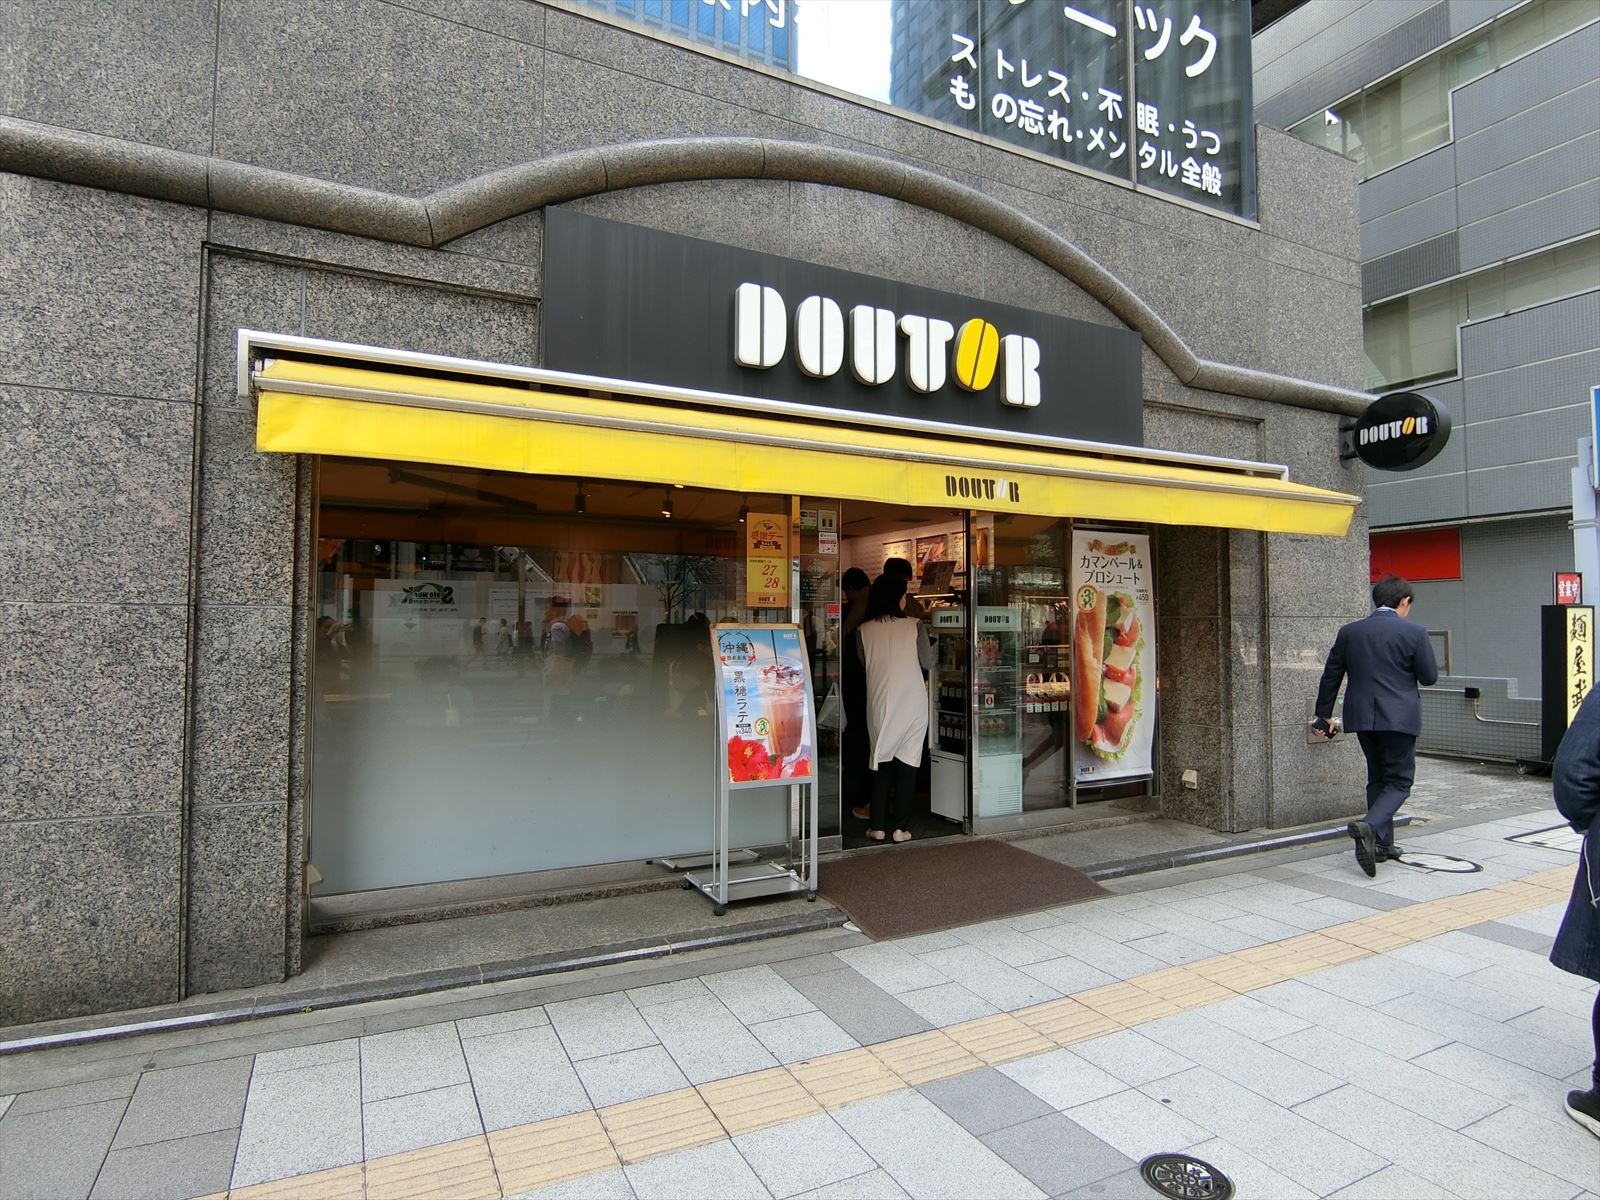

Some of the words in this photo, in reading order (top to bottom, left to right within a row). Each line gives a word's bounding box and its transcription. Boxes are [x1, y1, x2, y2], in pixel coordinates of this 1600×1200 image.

[735, 282, 1042, 408] DOUTOR
[1359, 416, 1428, 446] DOUTOR
[945, 475, 1020, 503] DOUTOR
[761, 564, 778, 575] 27
[1080, 555, 1143, 570] カマンベール&
[763, 577, 780, 588] 28
[1084, 569, 1140, 585] プロシュート
[984, 615, 1010, 624] DOUTOR
[722, 642, 749, 653] 沖縄
[734, 671, 748, 723] 黒糖ラテ
